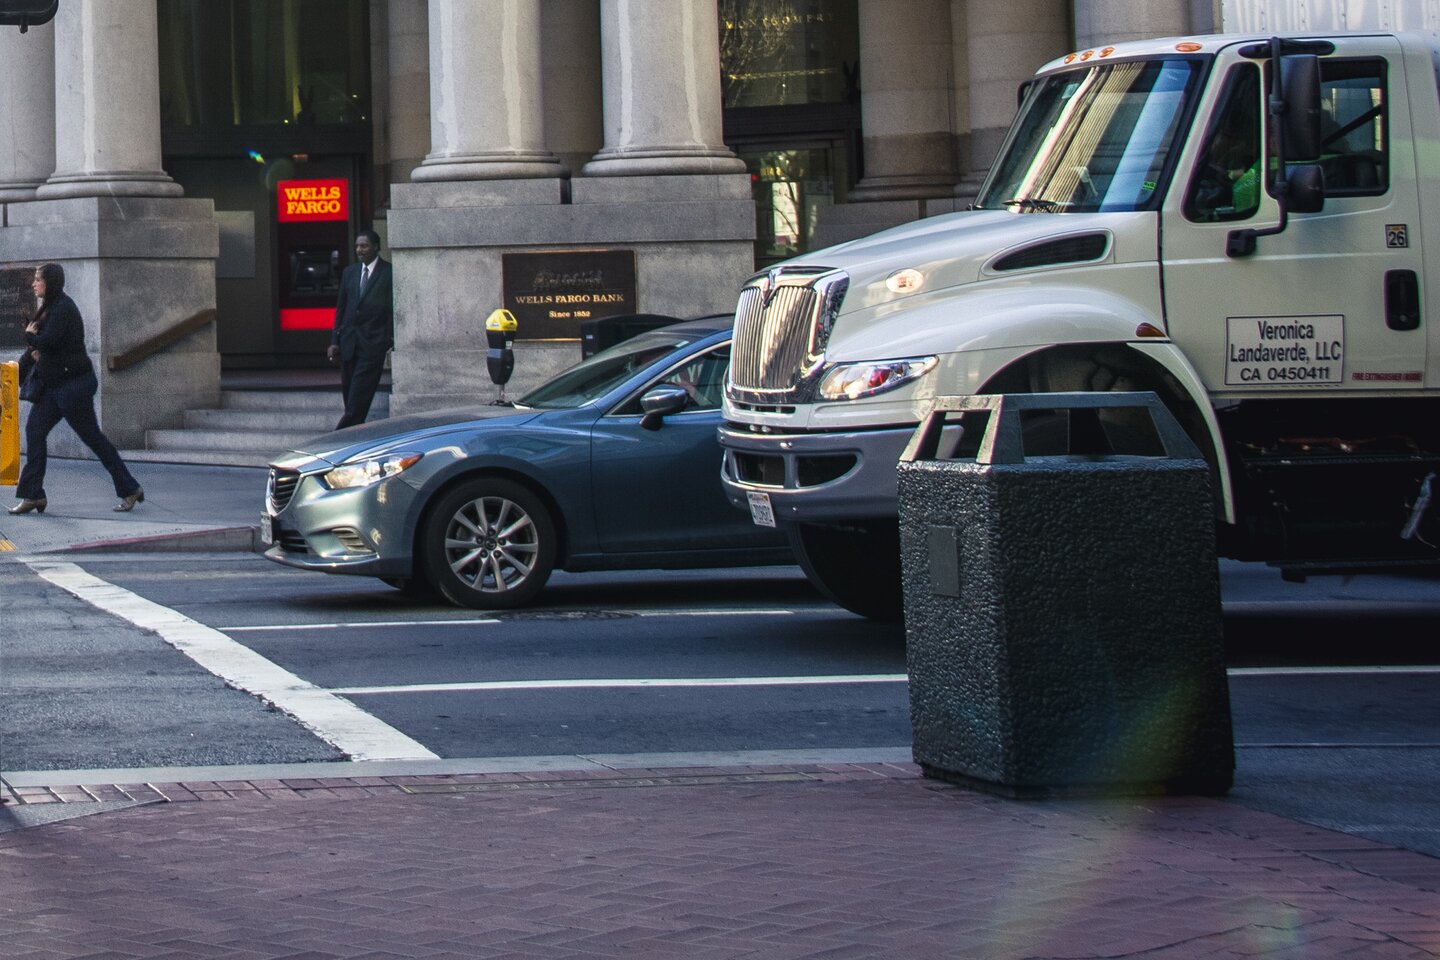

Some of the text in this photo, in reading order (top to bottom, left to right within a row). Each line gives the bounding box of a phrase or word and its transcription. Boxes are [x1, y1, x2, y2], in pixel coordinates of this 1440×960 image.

[284, 186, 341, 201] WELLS
[286, 200, 341, 215] FARGO
[1388, 230, 1404, 246] 26
[515, 293, 625, 304] WELLS FARGO BANK
[548, 310, 570, 318] Since
[1257, 320, 1314, 340] Veronica
[1230, 341, 1341, 364] Landaverde, LLC
[1240, 366, 1329, 381] CA 0450411
